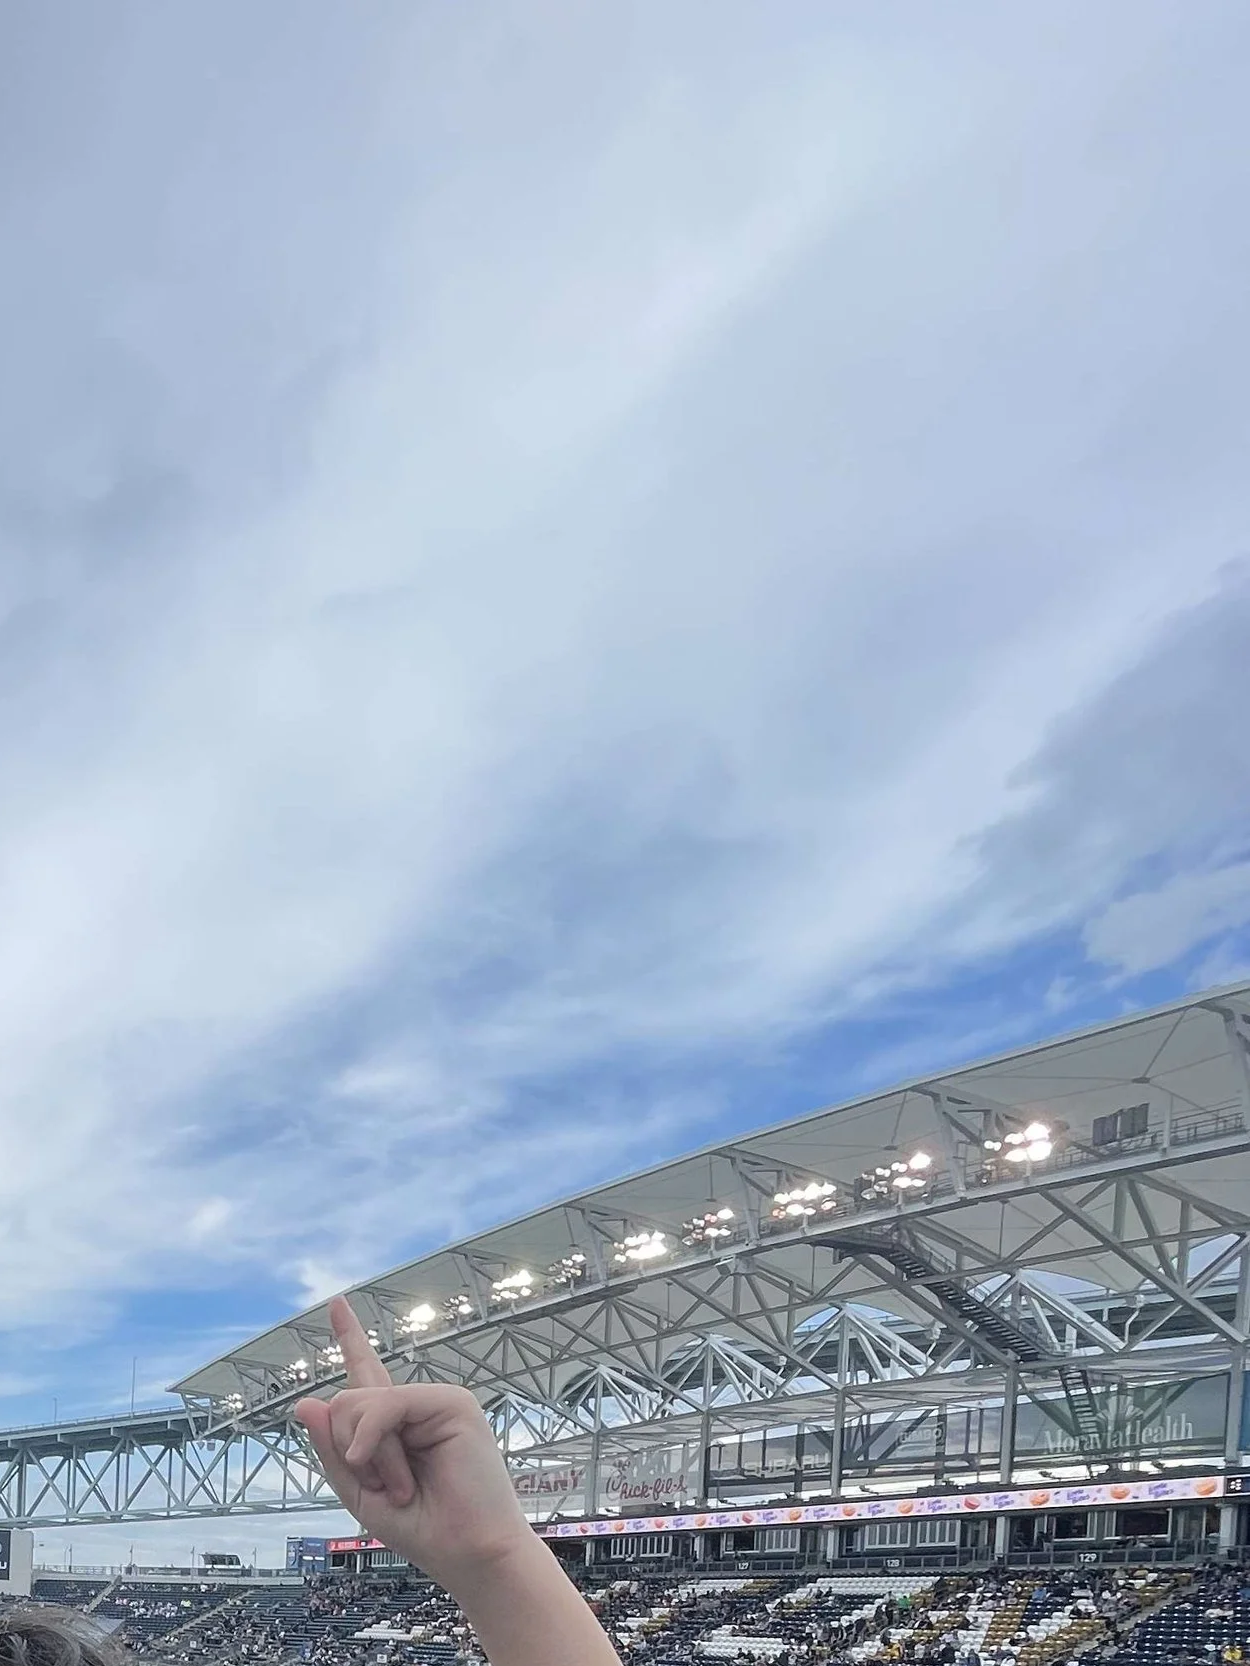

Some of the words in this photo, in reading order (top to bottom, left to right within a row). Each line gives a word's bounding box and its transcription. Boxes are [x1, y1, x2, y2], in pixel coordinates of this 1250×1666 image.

[743, 1453, 831, 1478] SUBARU
[515, 1466, 585, 1495] GIANT
[1079, 1553, 1097, 1563] 129
[738, 1562, 749, 1571] 127
[886, 1559, 900, 1568] 128
